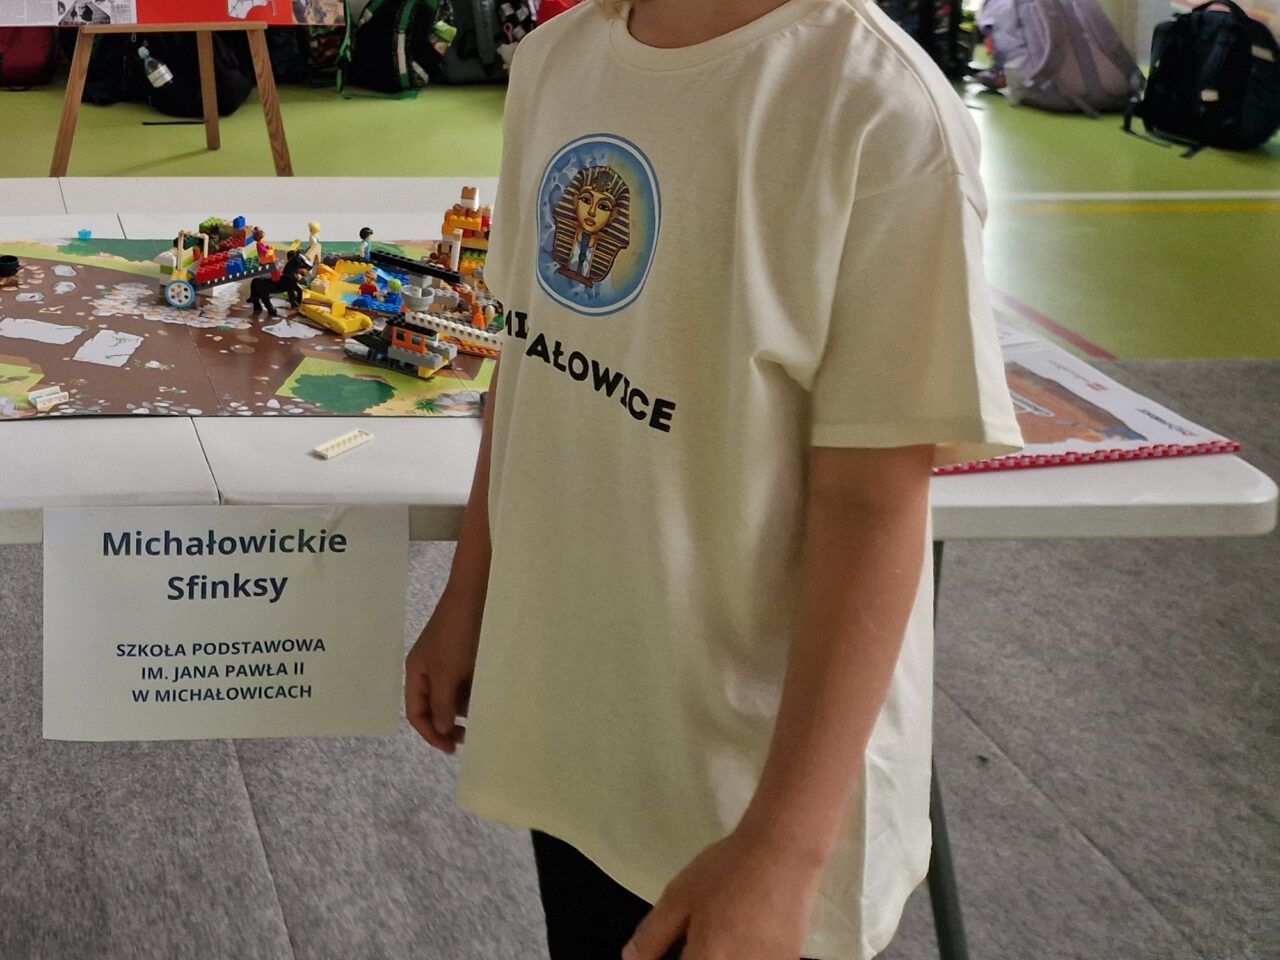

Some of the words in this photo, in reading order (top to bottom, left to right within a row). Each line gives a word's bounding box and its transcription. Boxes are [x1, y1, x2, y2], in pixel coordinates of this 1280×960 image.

[102, 528, 348, 557] Michałowickie
[167, 573, 289, 603] Sfinksy
[116, 643, 186, 658] SZKOŁA
[192, 638, 326, 656] PODSTAWOWA
[141, 666, 169, 681] IM.
[173, 664, 219, 683] JANA
[225, 662, 288, 678] PAWŁA
[293, 662, 305, 676] II
[132, 688, 150, 703] W
[155, 684, 313, 703] MICHAŁOWICACH
